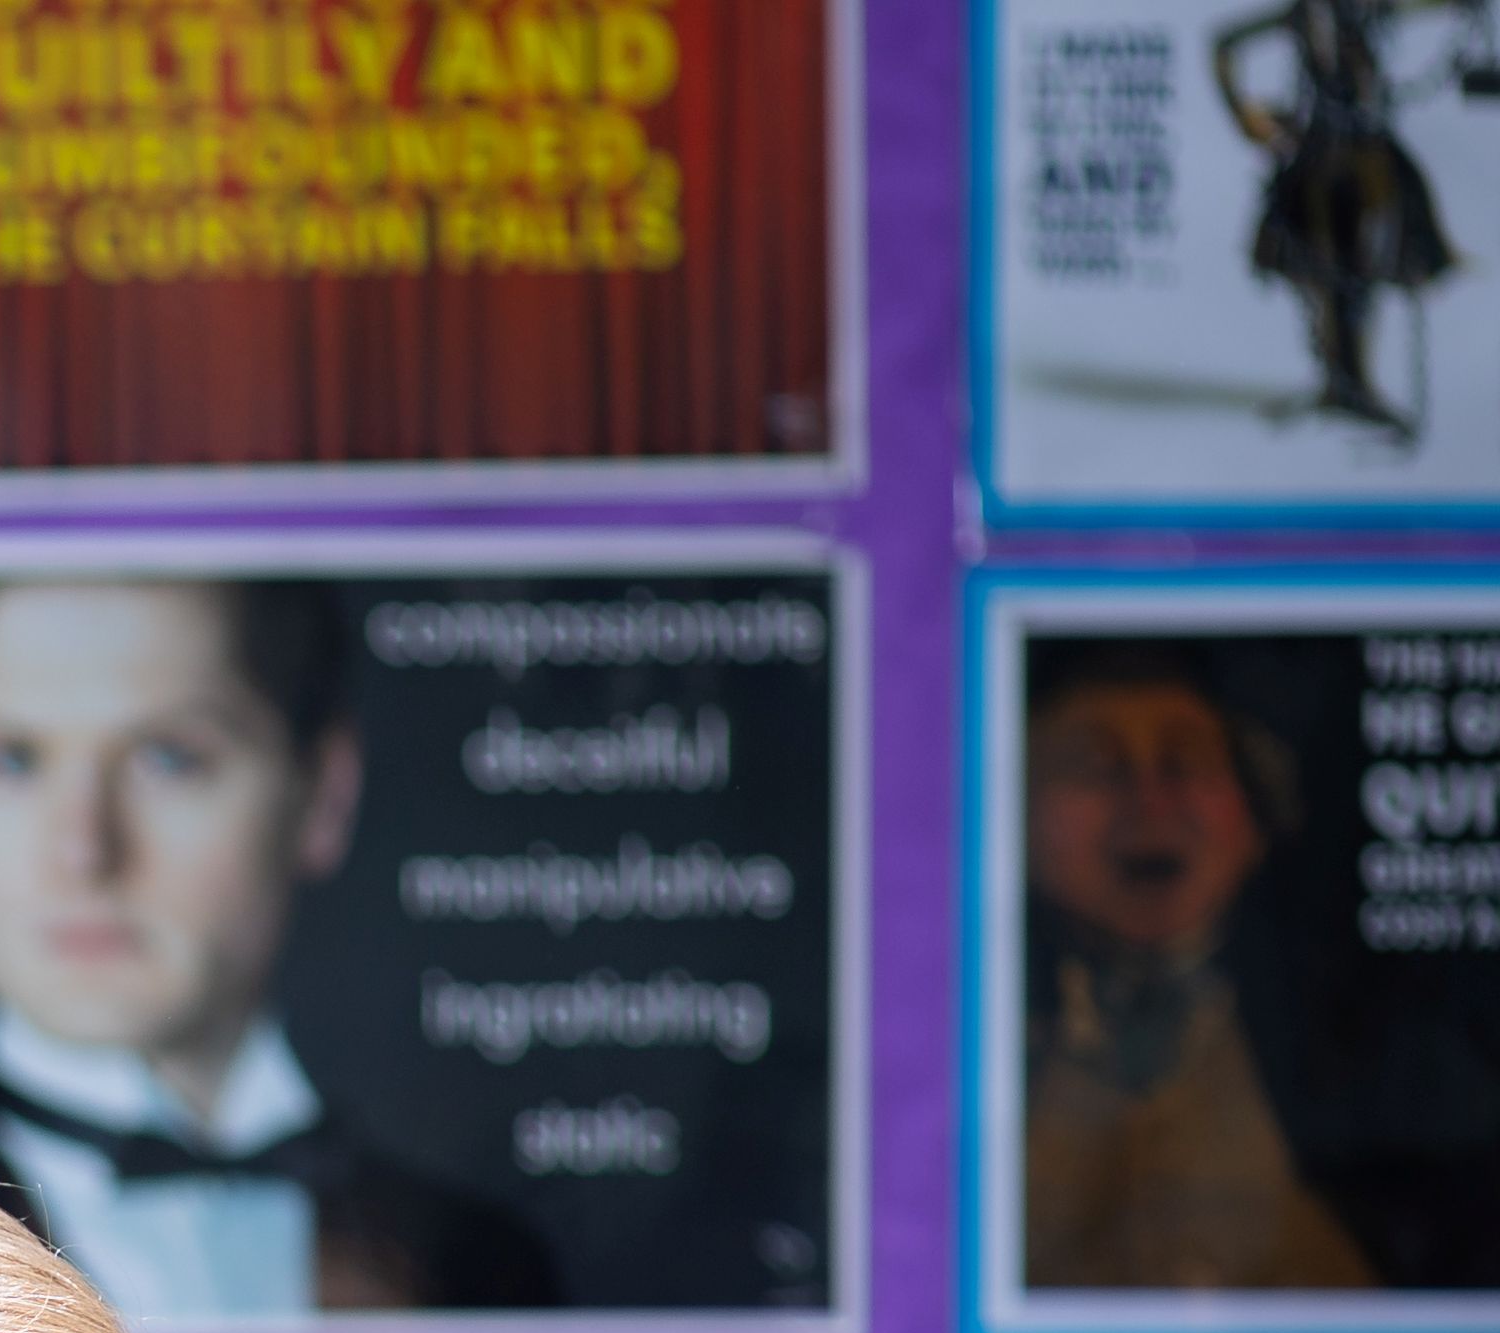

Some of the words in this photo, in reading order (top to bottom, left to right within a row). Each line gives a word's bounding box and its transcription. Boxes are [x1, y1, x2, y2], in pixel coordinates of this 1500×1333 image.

[422, 5, 680, 108] AND
[73, 194, 426, 279] CURTAIN
[436, 190, 682, 272] FALLS
[365, 588, 827, 681] compassionate
[463, 704, 731, 793] deceitful
[401, 836, 792, 935] manipulative
[421, 967, 772, 1063] ingratiating
[514, 1097, 681, 1175] static
